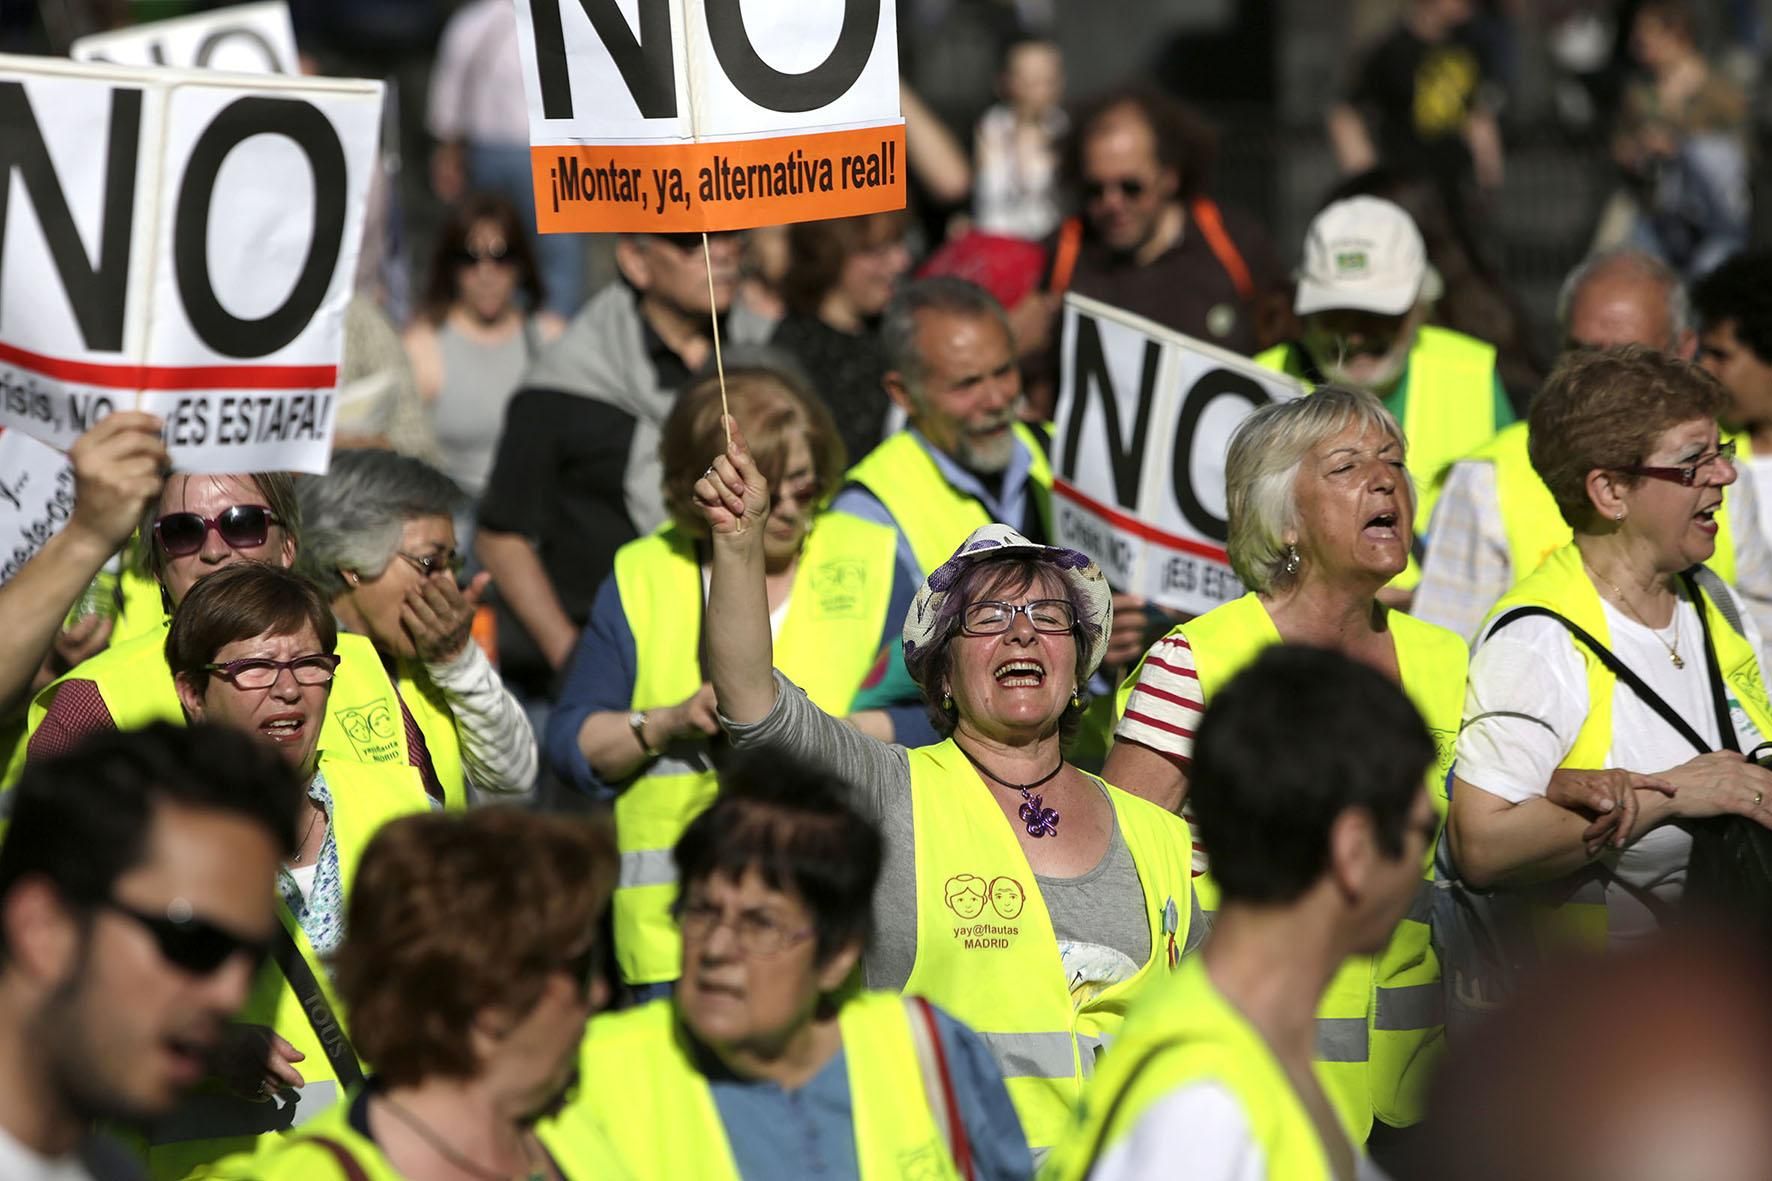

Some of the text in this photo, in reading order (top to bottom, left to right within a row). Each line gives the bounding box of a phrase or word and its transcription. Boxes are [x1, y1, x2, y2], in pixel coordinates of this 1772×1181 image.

[551, 141, 896, 214] ¡Montar, ya, alternativa real!
[0, 81, 348, 359] NO
[218, 395, 333, 445] ESTAFA!
[953, 924, 1019, 938] yay@flautas
[964, 938, 1009, 949] MADRID
